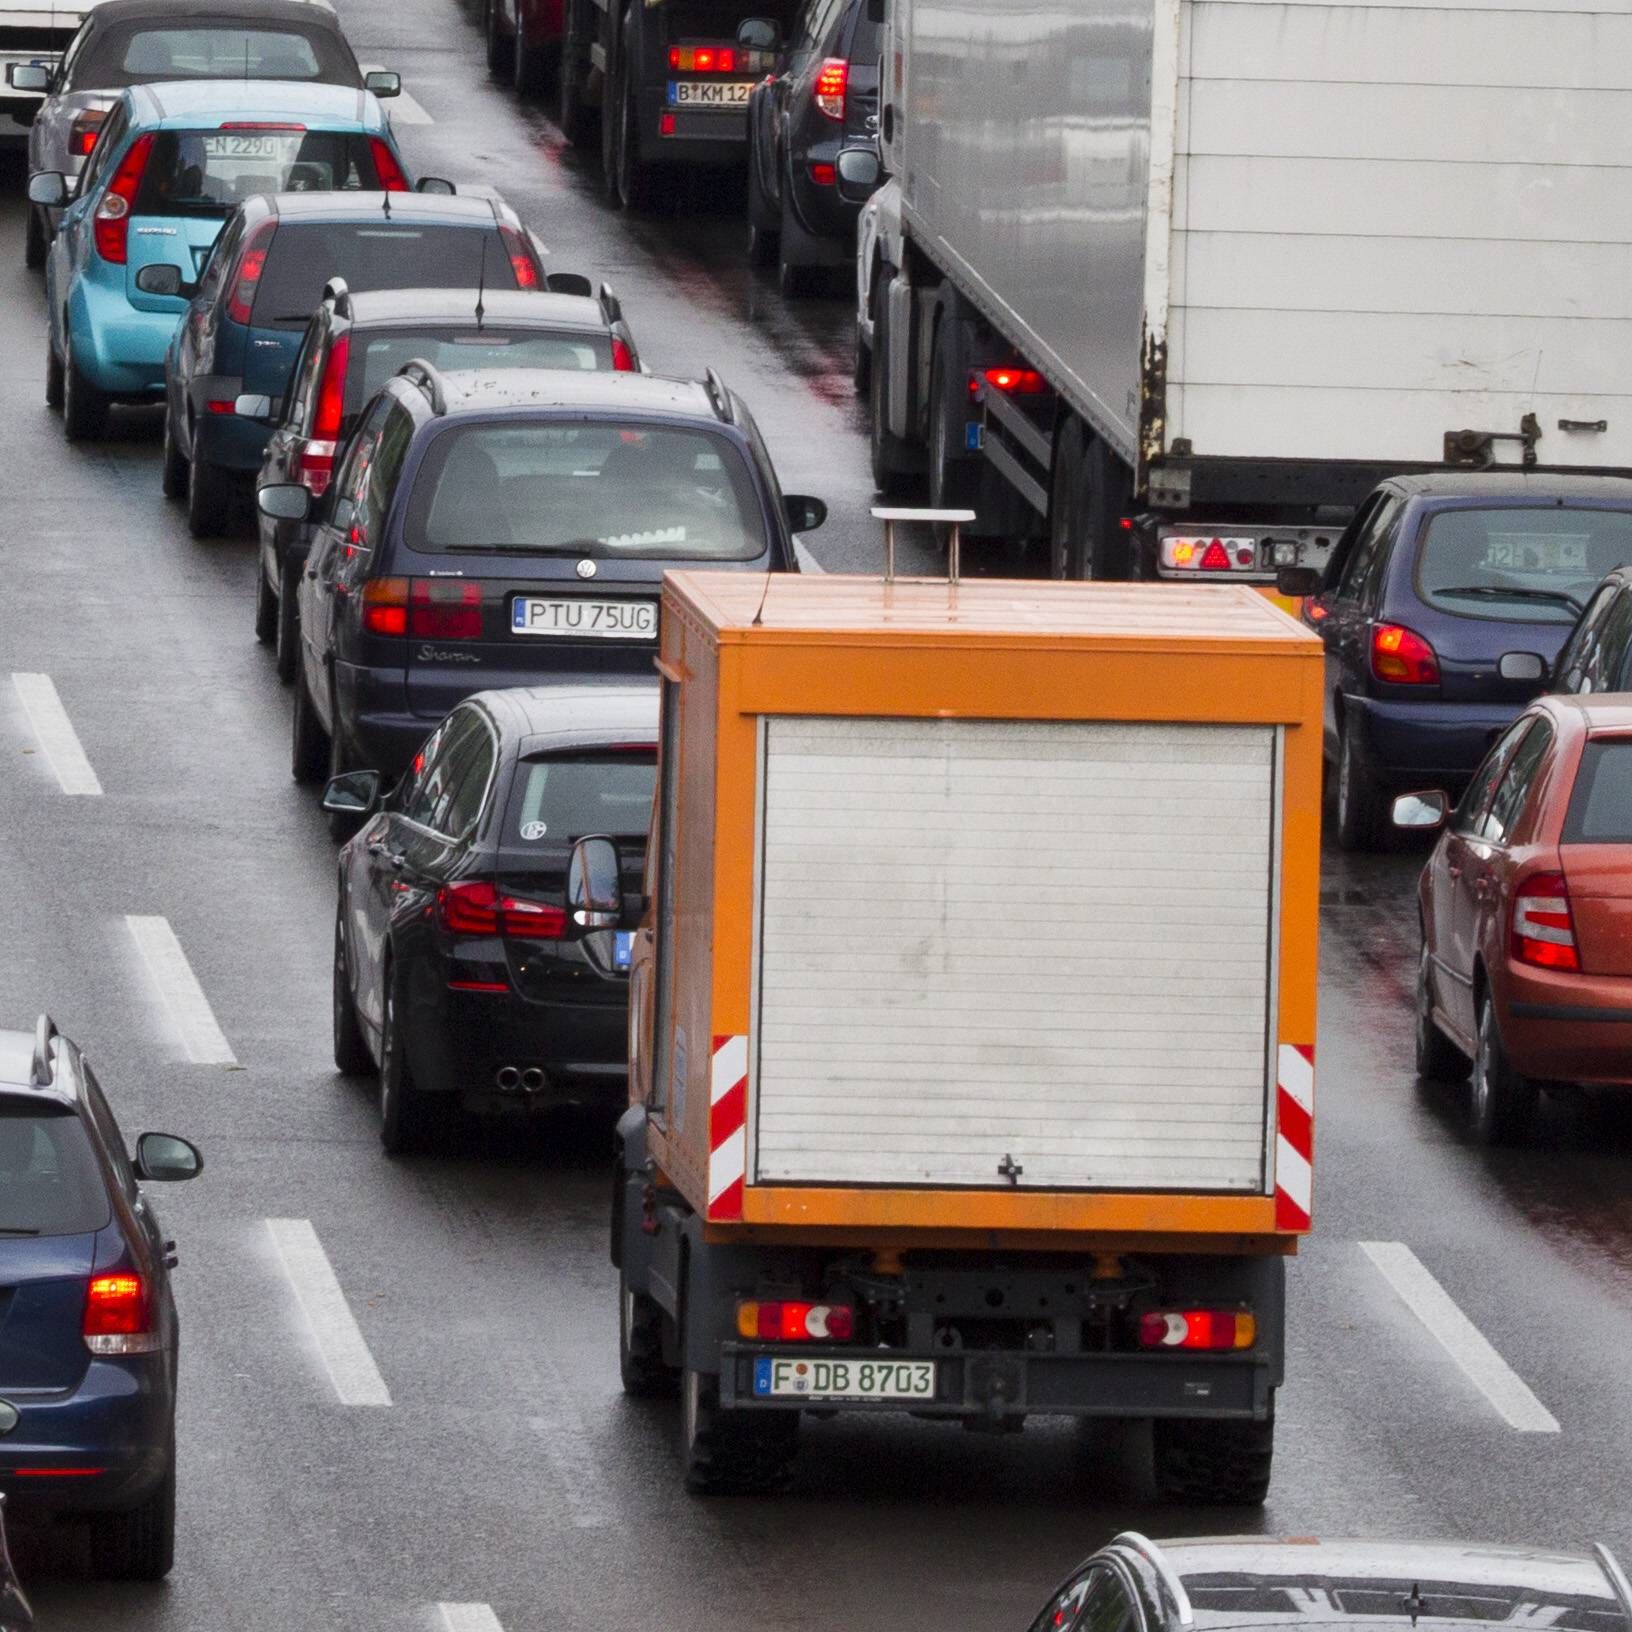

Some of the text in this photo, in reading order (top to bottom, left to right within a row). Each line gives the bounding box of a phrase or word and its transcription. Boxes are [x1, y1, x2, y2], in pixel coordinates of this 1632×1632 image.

[679, 84, 690, 102] B
[700, 85, 724, 102] KM
[530, 603, 651, 631] PTU 75UG
[773, 1362, 931, 1393] F DB 8703
